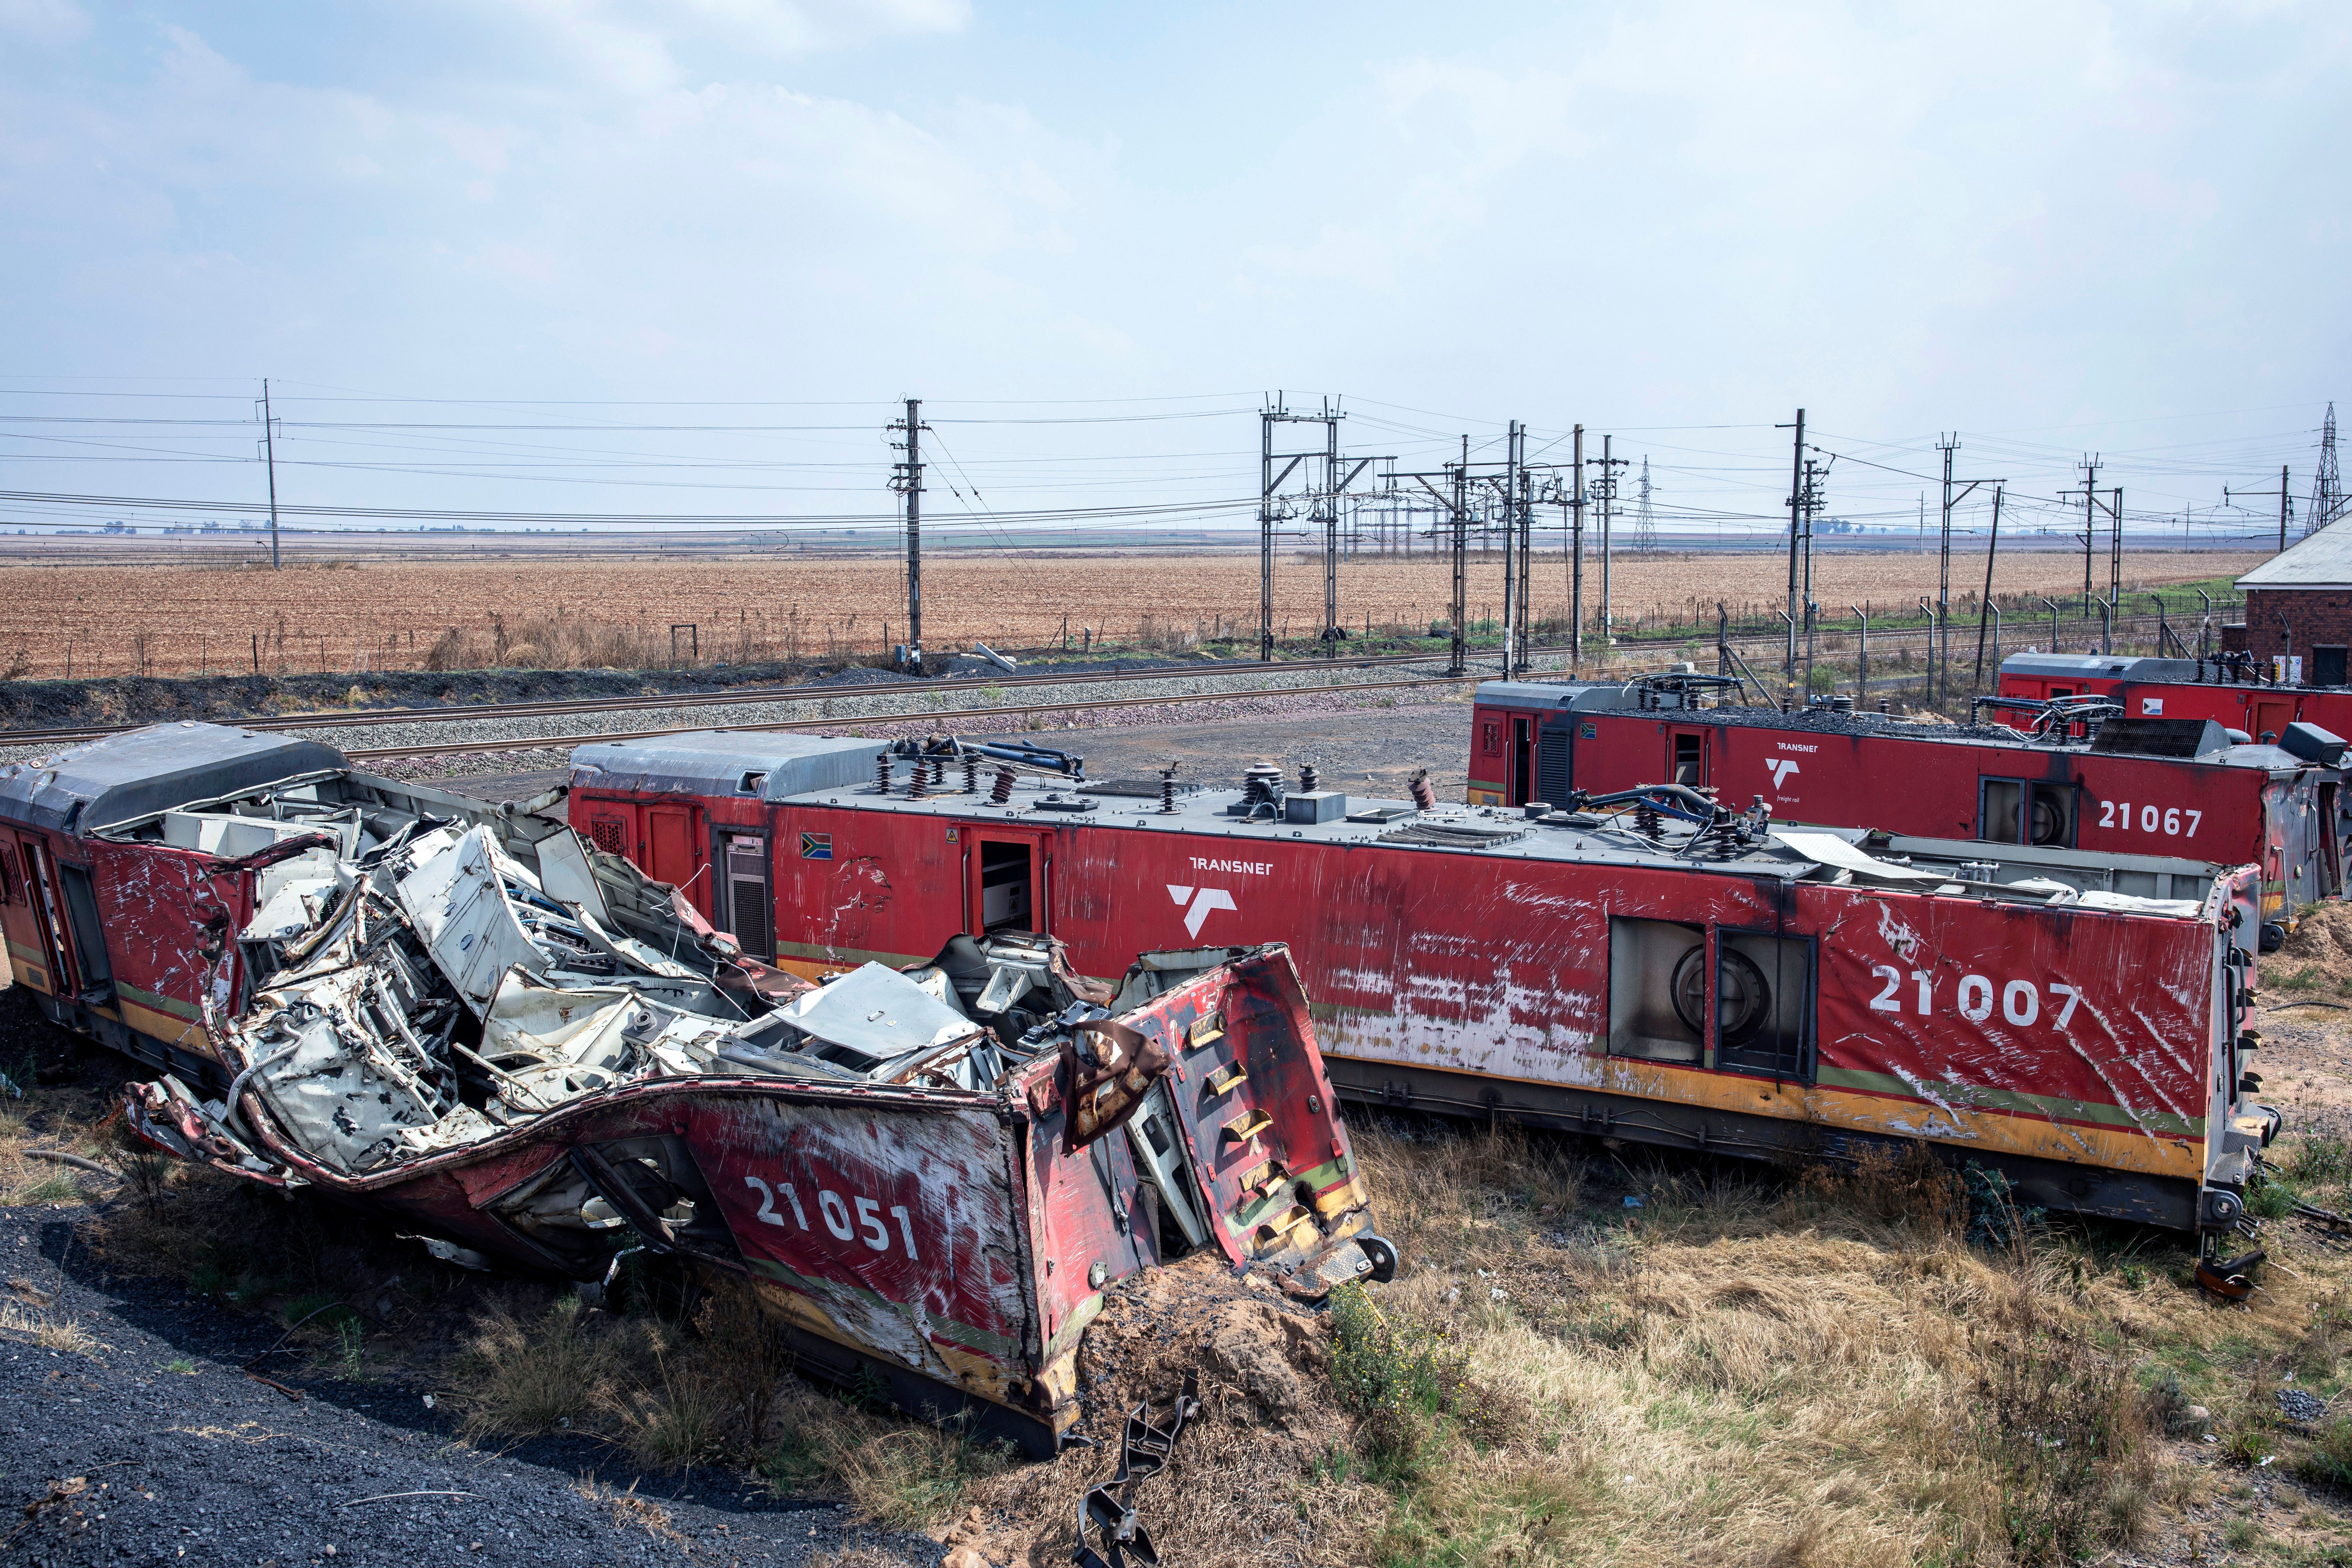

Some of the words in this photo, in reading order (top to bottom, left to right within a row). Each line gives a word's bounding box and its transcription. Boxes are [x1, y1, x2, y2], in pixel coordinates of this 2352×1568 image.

[1777, 742, 1818, 753] TRANSNET
[2099, 801, 2130, 830] 21
[2141, 805, 2202, 838] 067
[1189, 857, 1273, 875] TRANSNET
[1870, 965, 1932, 1016] 21
[1958, 974, 2082, 1031] 007
[745, 1176, 809, 1231] 21
[818, 1190, 918, 1261] 051
